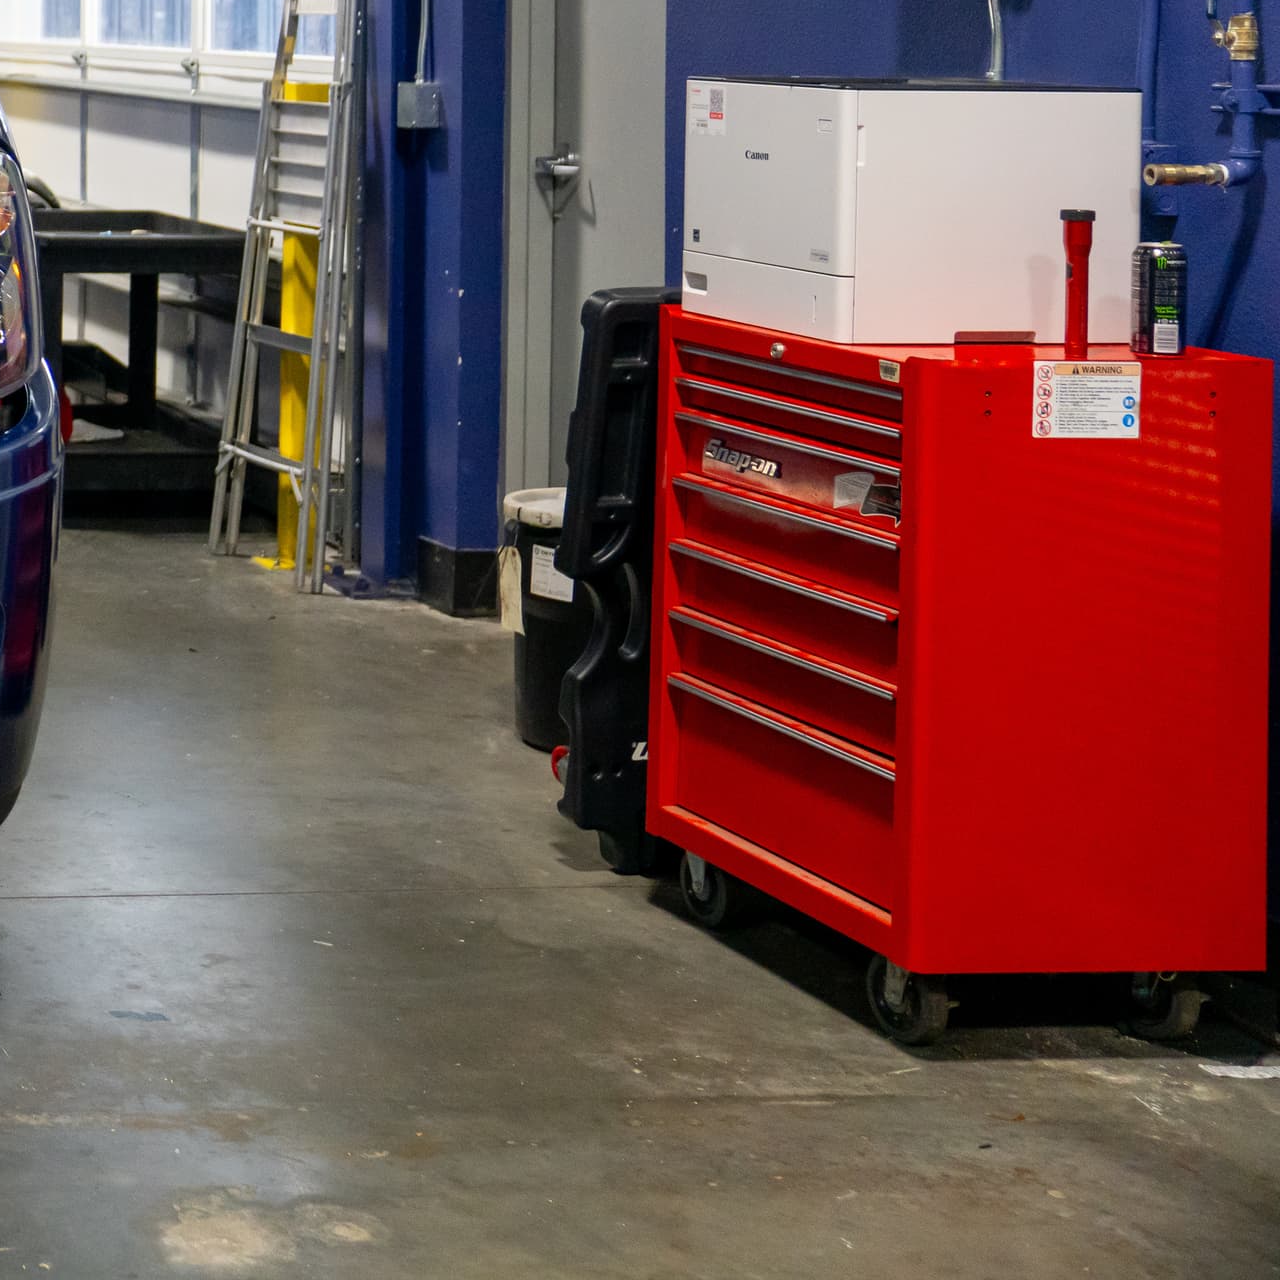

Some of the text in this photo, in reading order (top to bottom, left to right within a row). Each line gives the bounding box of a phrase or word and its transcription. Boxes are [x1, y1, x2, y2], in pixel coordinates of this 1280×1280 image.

[744, 149, 770, 161] Canon
[1081, 365, 1123, 375] WARNING
[704, 438, 779, 478] Snap-on
